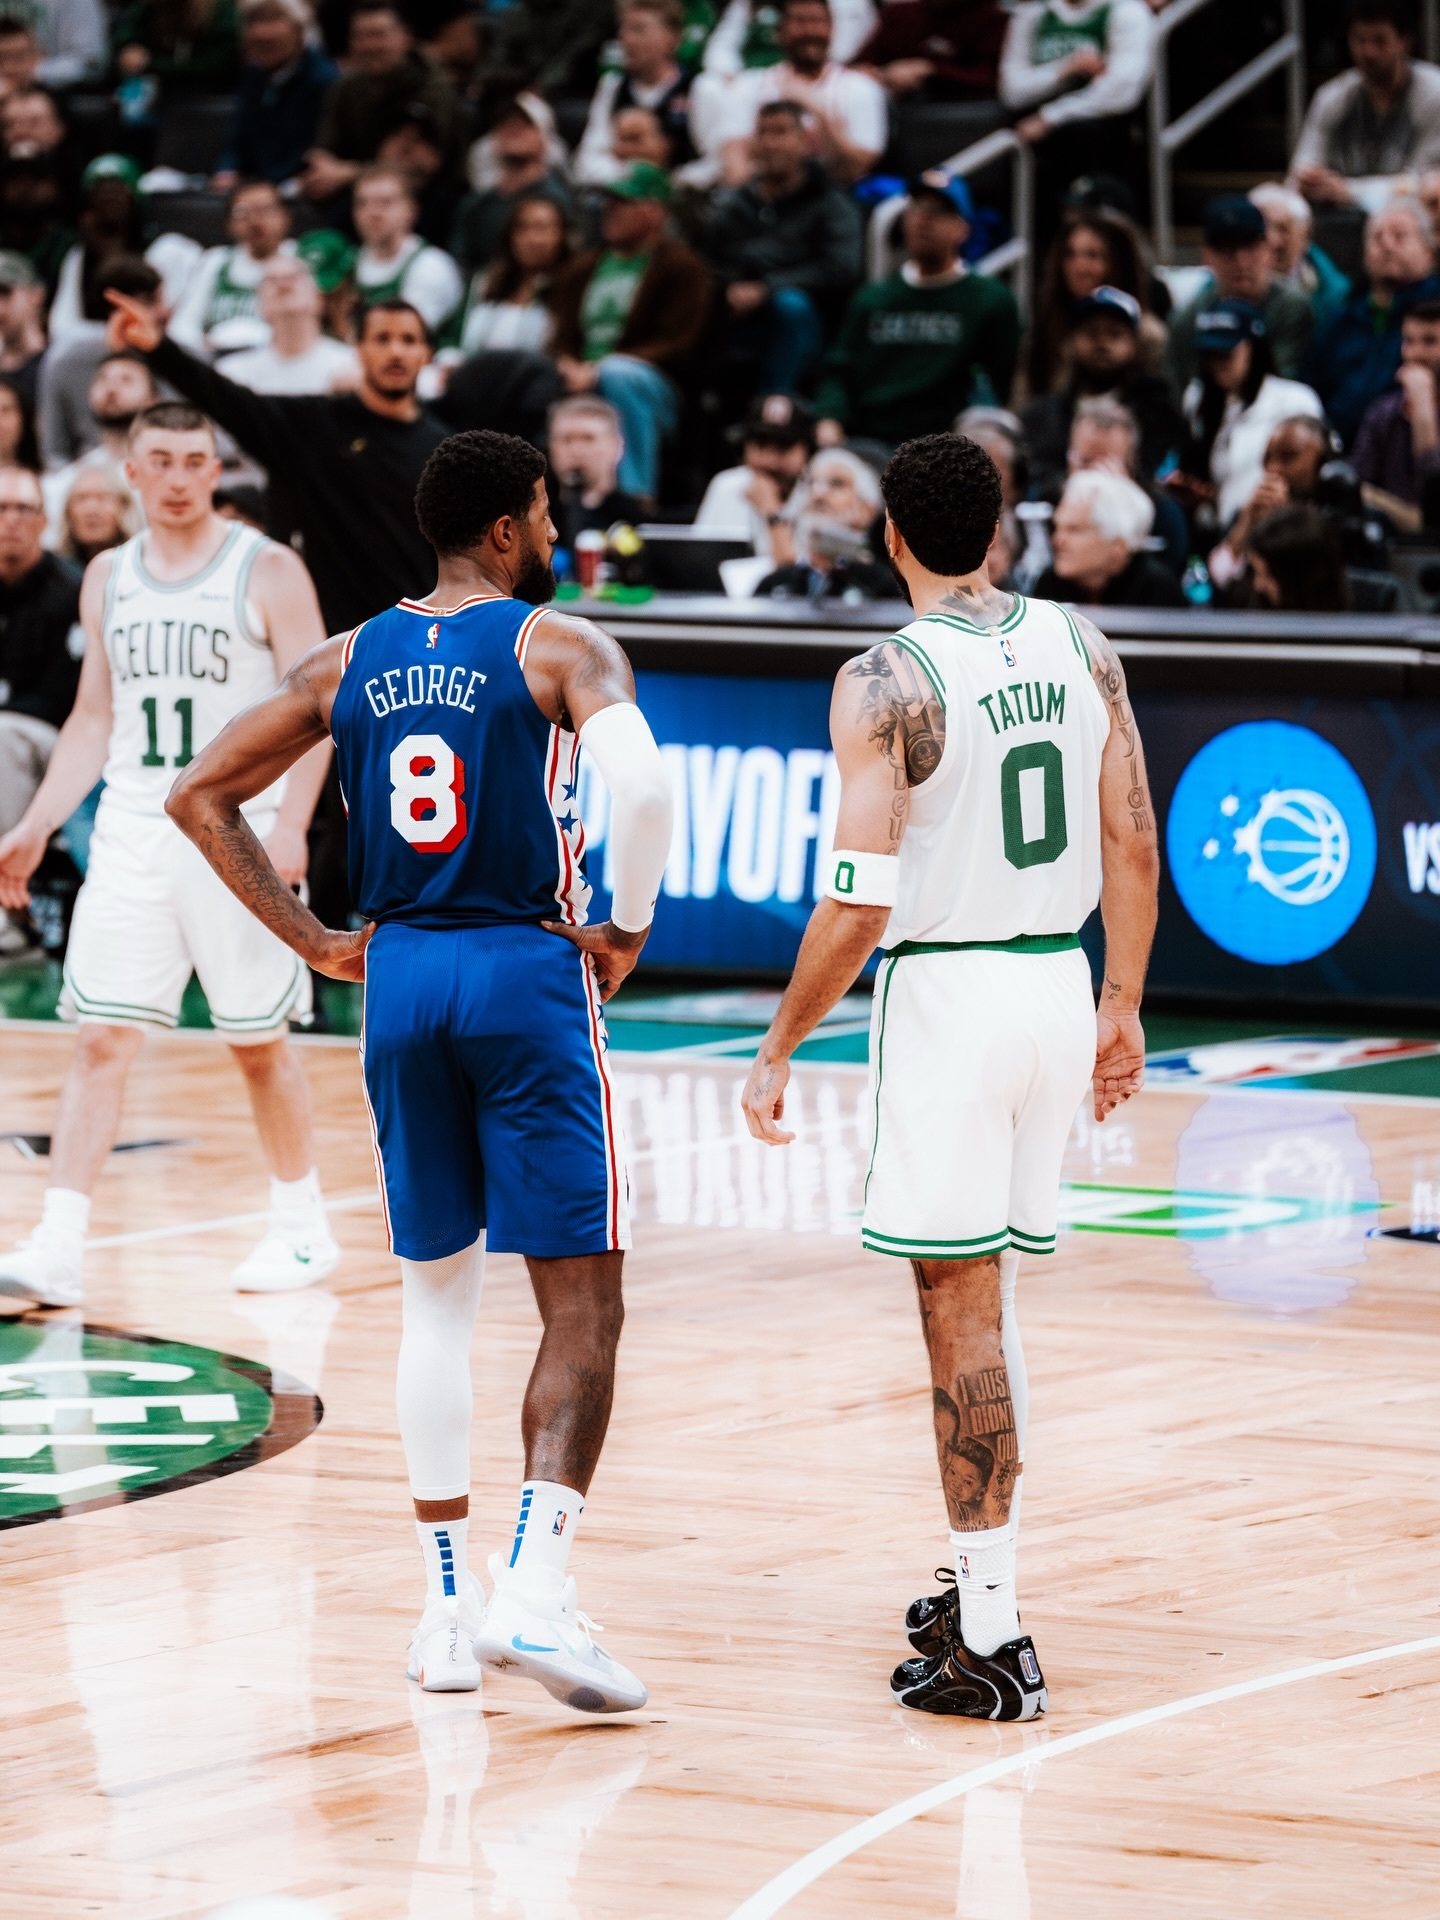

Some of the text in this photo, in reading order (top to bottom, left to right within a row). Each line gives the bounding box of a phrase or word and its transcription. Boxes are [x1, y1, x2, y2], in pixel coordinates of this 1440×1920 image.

[111, 620, 230, 684] CELTICS
[364, 664, 487, 718] GEORGE
[977, 681, 1066, 735] TATUM
[141, 697, 197, 768] 11
[389, 734, 468, 854] 8
[1000, 740, 1068, 871] 0
[835, 860, 855, 894] 0
[448, 1619, 458, 1662] PAUL
